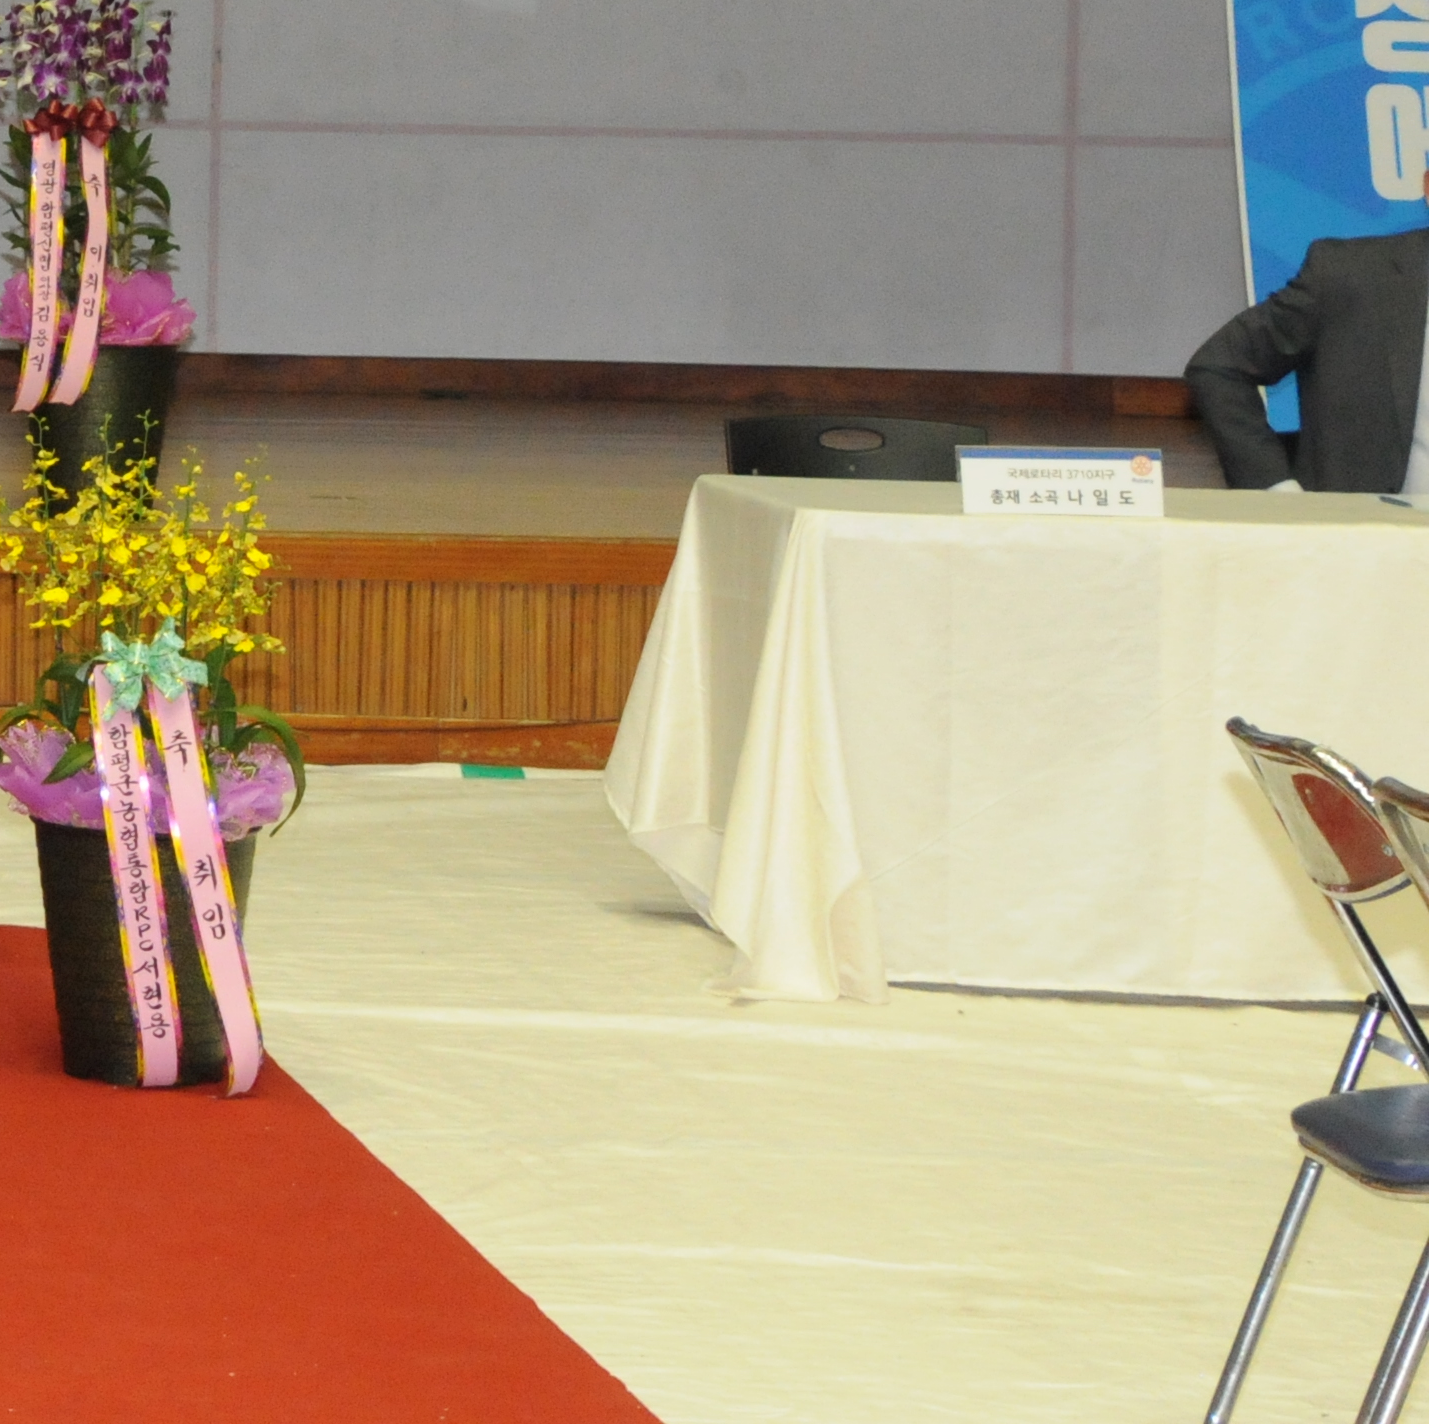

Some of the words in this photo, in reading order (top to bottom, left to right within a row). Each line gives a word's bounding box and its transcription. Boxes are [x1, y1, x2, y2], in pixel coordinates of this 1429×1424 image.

[1007, 467, 1063, 481] 국제로타리
[990, 488, 1021, 506] 총재
[164, 727, 193, 773] 축
